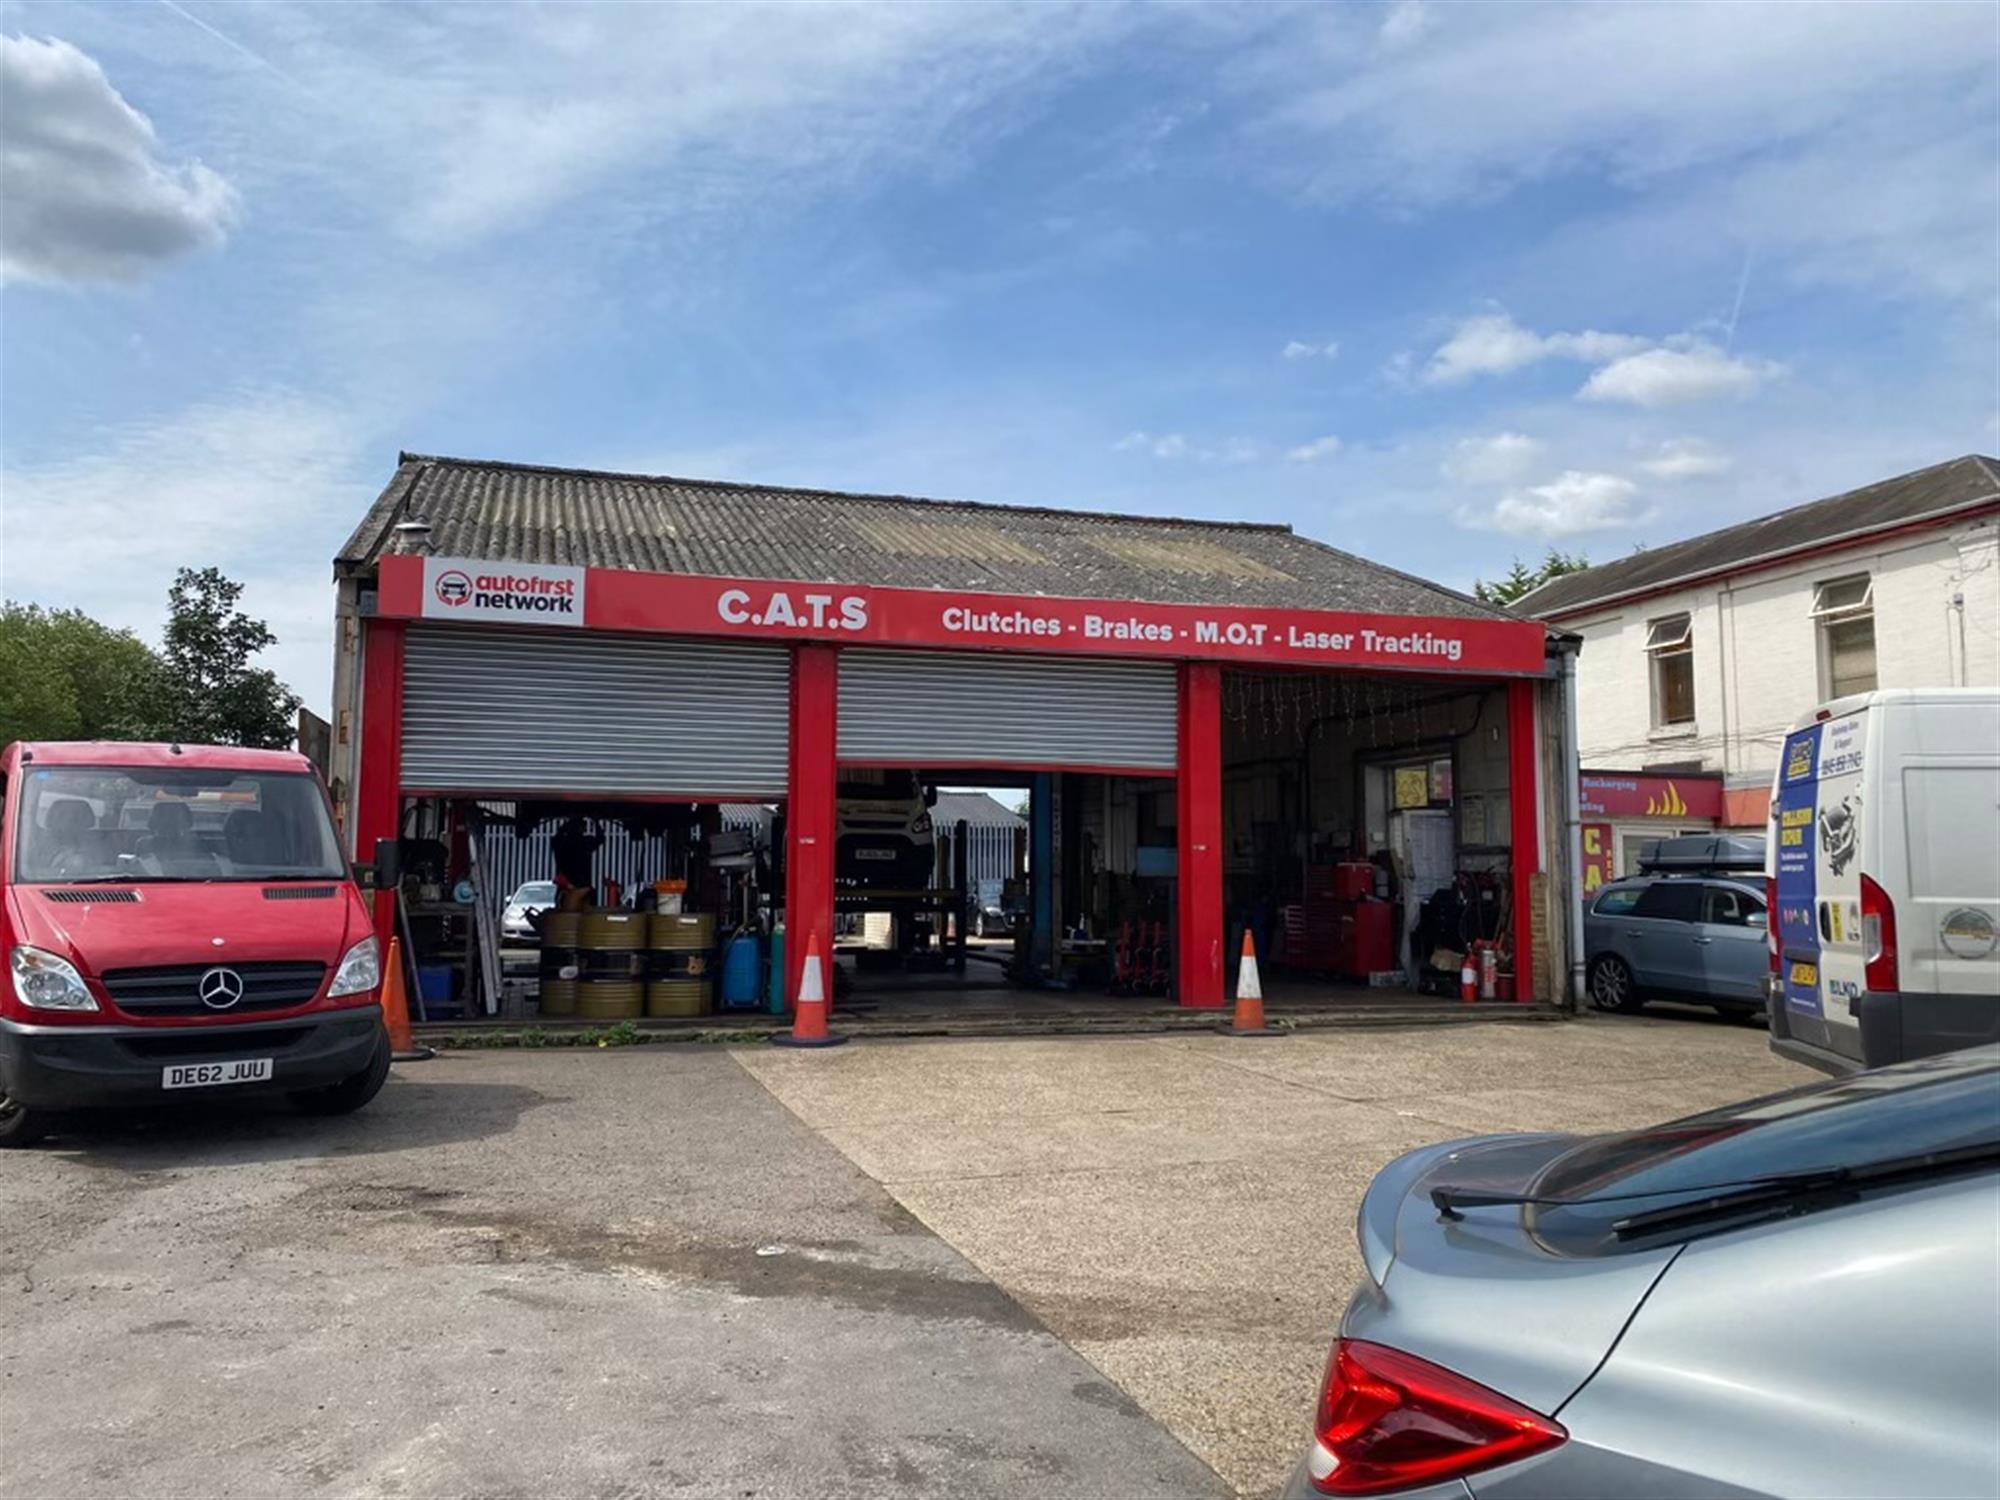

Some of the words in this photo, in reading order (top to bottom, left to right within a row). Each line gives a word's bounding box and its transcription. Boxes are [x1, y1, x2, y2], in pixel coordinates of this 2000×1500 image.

[475, 575, 575, 596] autofirst
[474, 593, 573, 613] network
[717, 589, 869, 630] C.A.T.S
[942, 607, 1062, 636] Clutches
[1084, 614, 1174, 642] Brakes
[1195, 621, 1268, 646] M.O.T
[1289, 626, 1354, 650] Laser
[1361, 629, 1462, 661] Tracking
[171, 1065, 222, 1085] DE62
[228, 1062, 265, 1080] JUU
